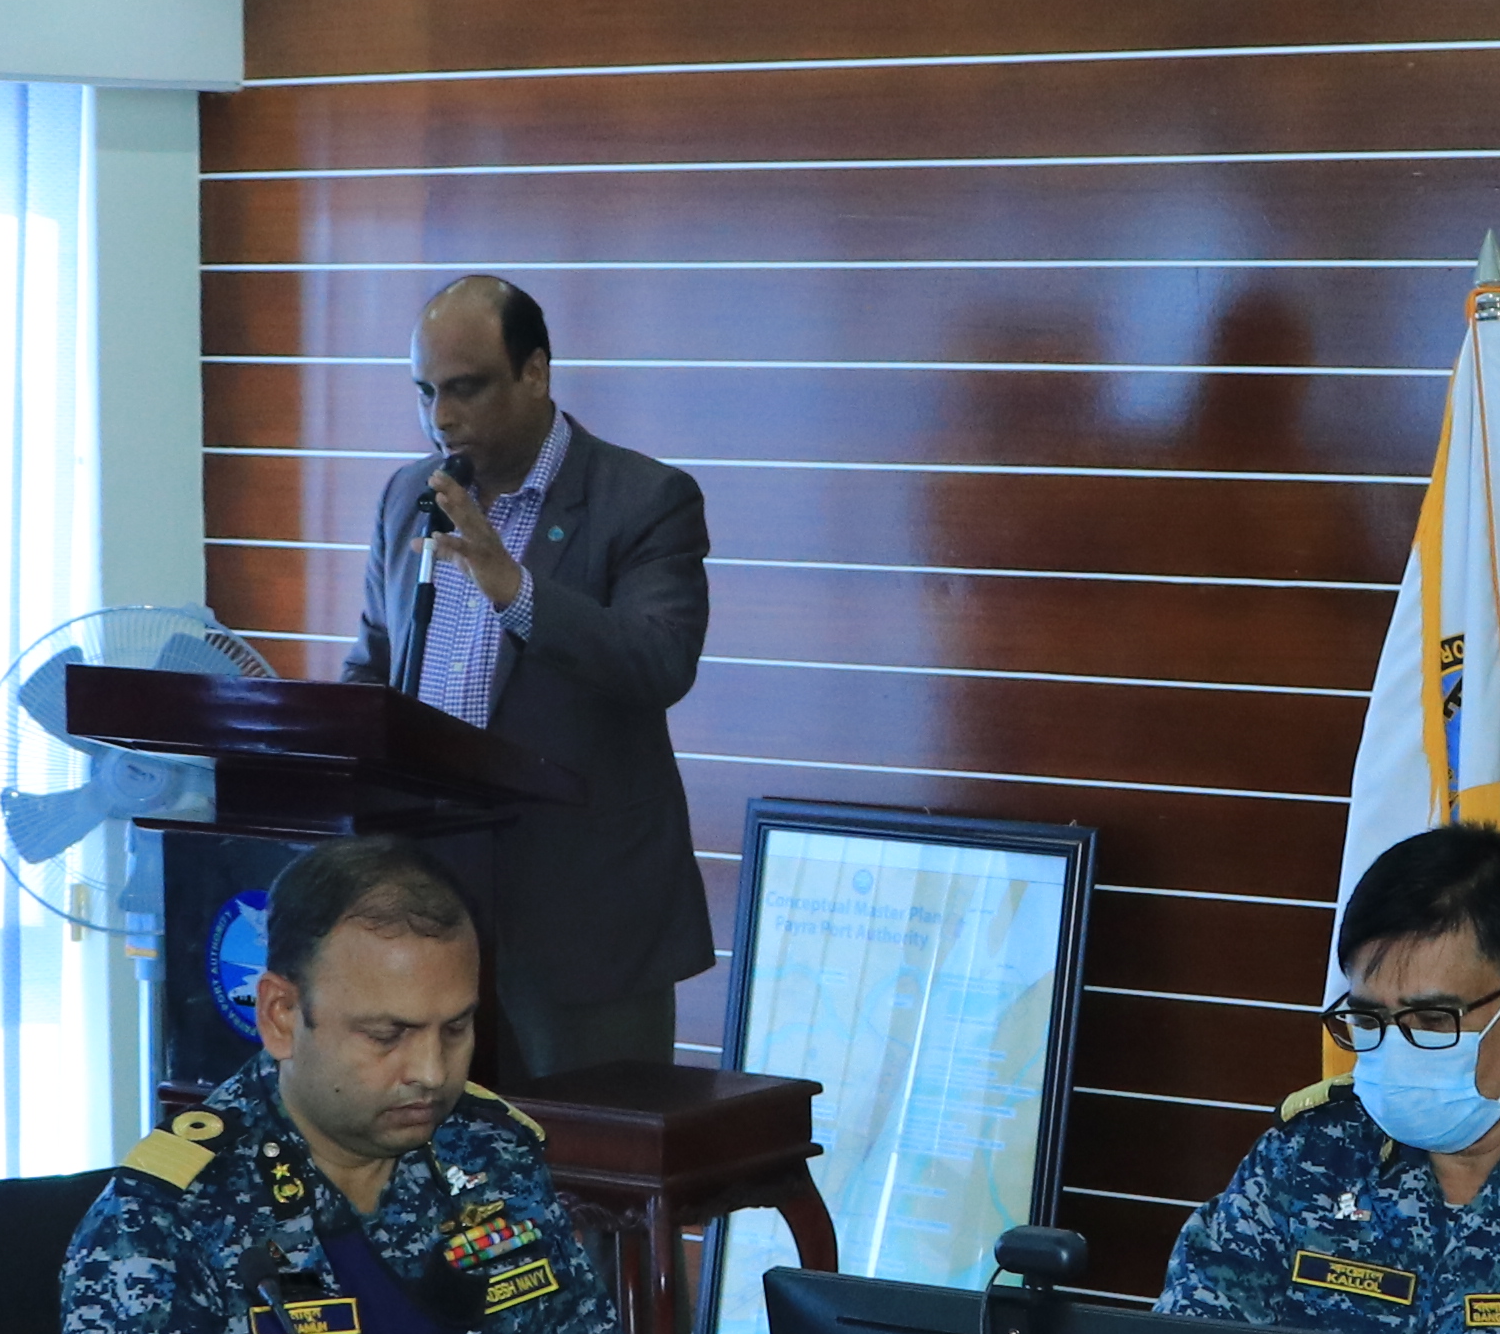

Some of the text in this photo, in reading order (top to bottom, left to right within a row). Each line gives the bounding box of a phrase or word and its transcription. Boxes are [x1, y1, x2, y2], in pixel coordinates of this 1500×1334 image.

[766, 891, 942, 924] Conceptual Master Plan
[775, 916, 929, 949] Payra Port Authority
[1327, 1273, 1382, 1292] KALLOL
